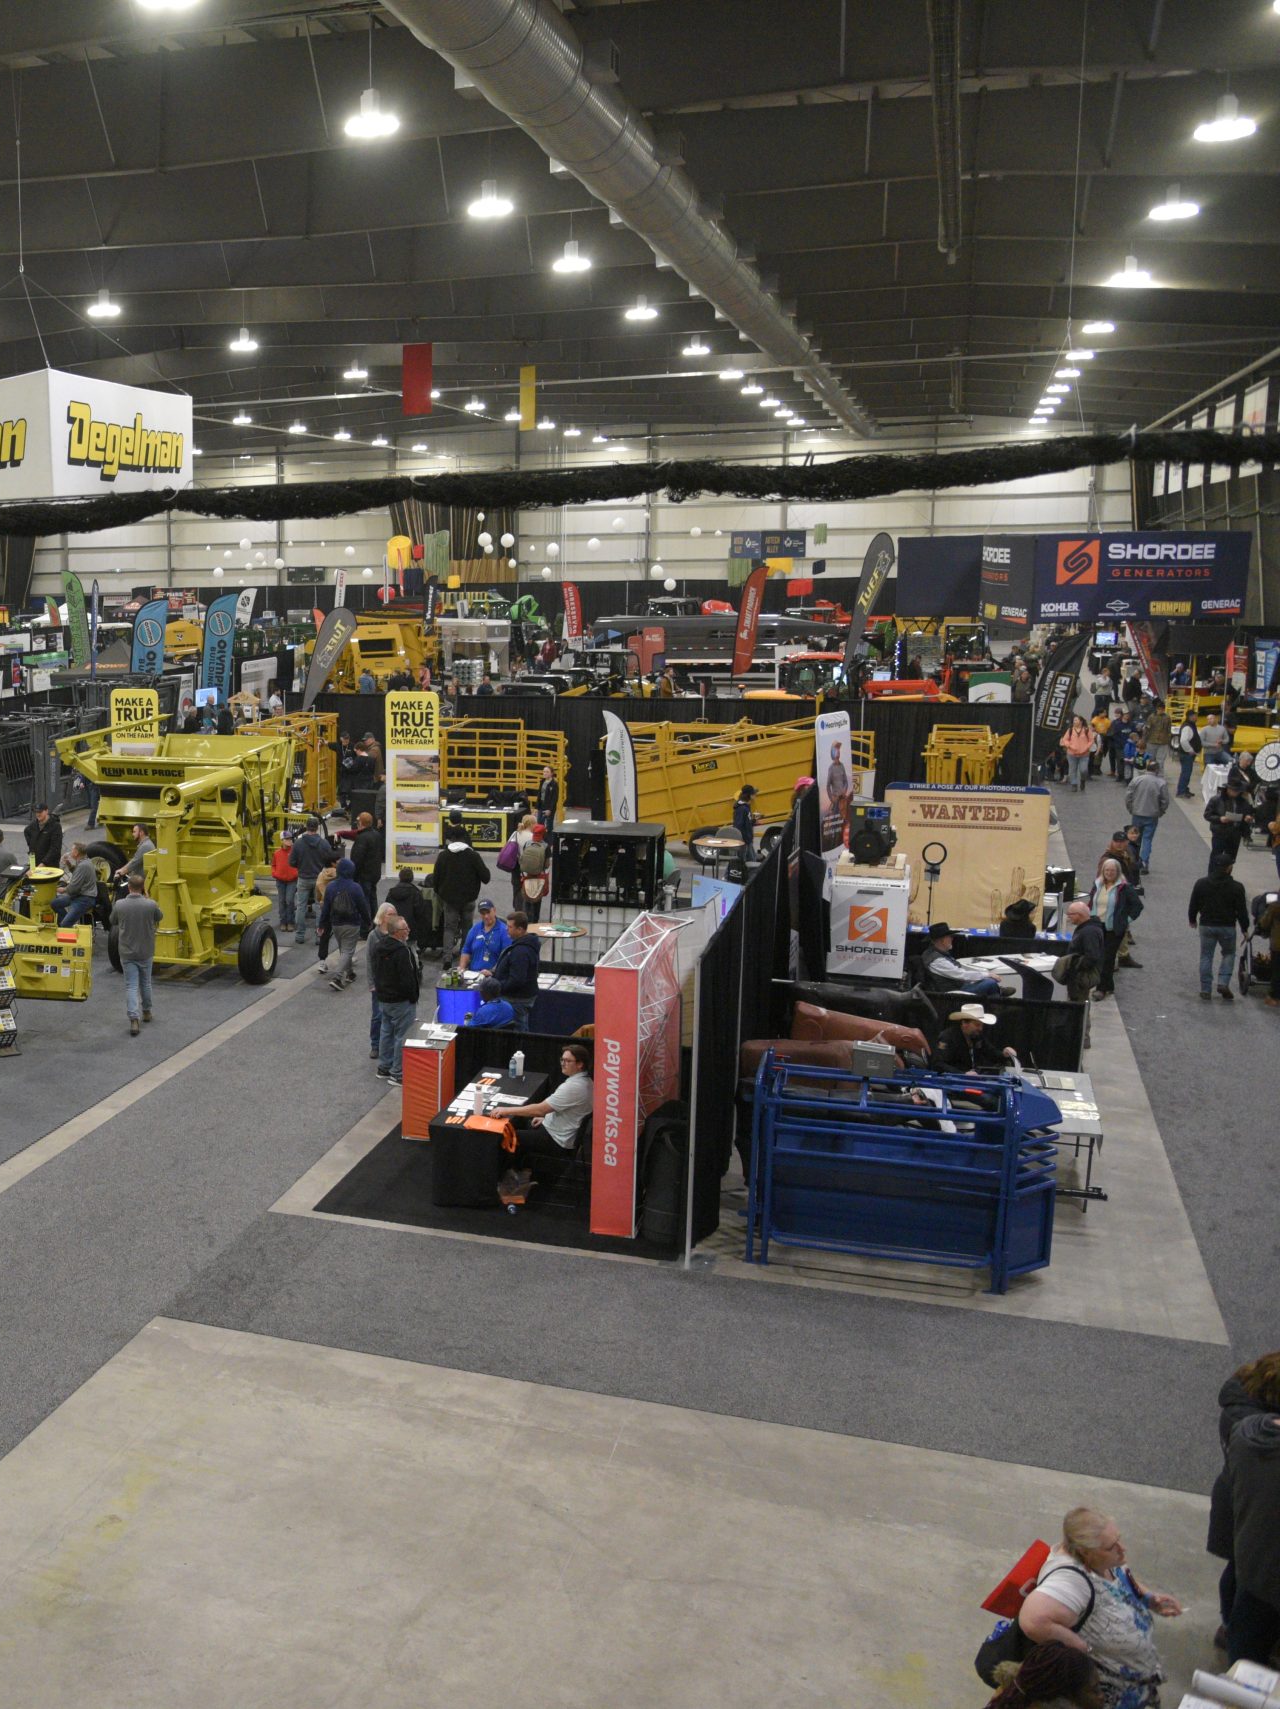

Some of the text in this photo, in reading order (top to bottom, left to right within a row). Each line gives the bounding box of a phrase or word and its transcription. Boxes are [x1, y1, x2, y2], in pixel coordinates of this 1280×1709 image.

[67, 400, 183, 481] Degelman
[1108, 543, 1216, 560] SHORDEE
[1112, 568, 1211, 578] GENERATORS
[858, 569, 881, 608] TUFF
[567, 586, 577, 634] UNRESERVED
[1040, 602, 1079, 612] KOHLER
[1150, 601, 1191, 613] CHAMPION
[1201, 598, 1241, 610] GENERAC
[1001, 606, 1028, 618] GENERAC
[1045, 670, 1056, 690] HEAVY
[115, 698, 153, 706] MAKE A
[391, 701, 434, 710] MAKE A
[1046, 676, 1070, 727] EMSCO
[115, 708, 154, 721] TRUE
[391, 712, 434, 727] TRUE
[391, 728, 434, 738] IMPACT
[101, 767, 125, 777] RENN
[126, 768, 148, 776] BALE
[921, 804, 1010, 822] WANTED
[14, 944, 85, 957] RUGRADE 16
[835, 945, 899, 956] SHORDEE
[603, 1038, 623, 1167] payworks.ca
